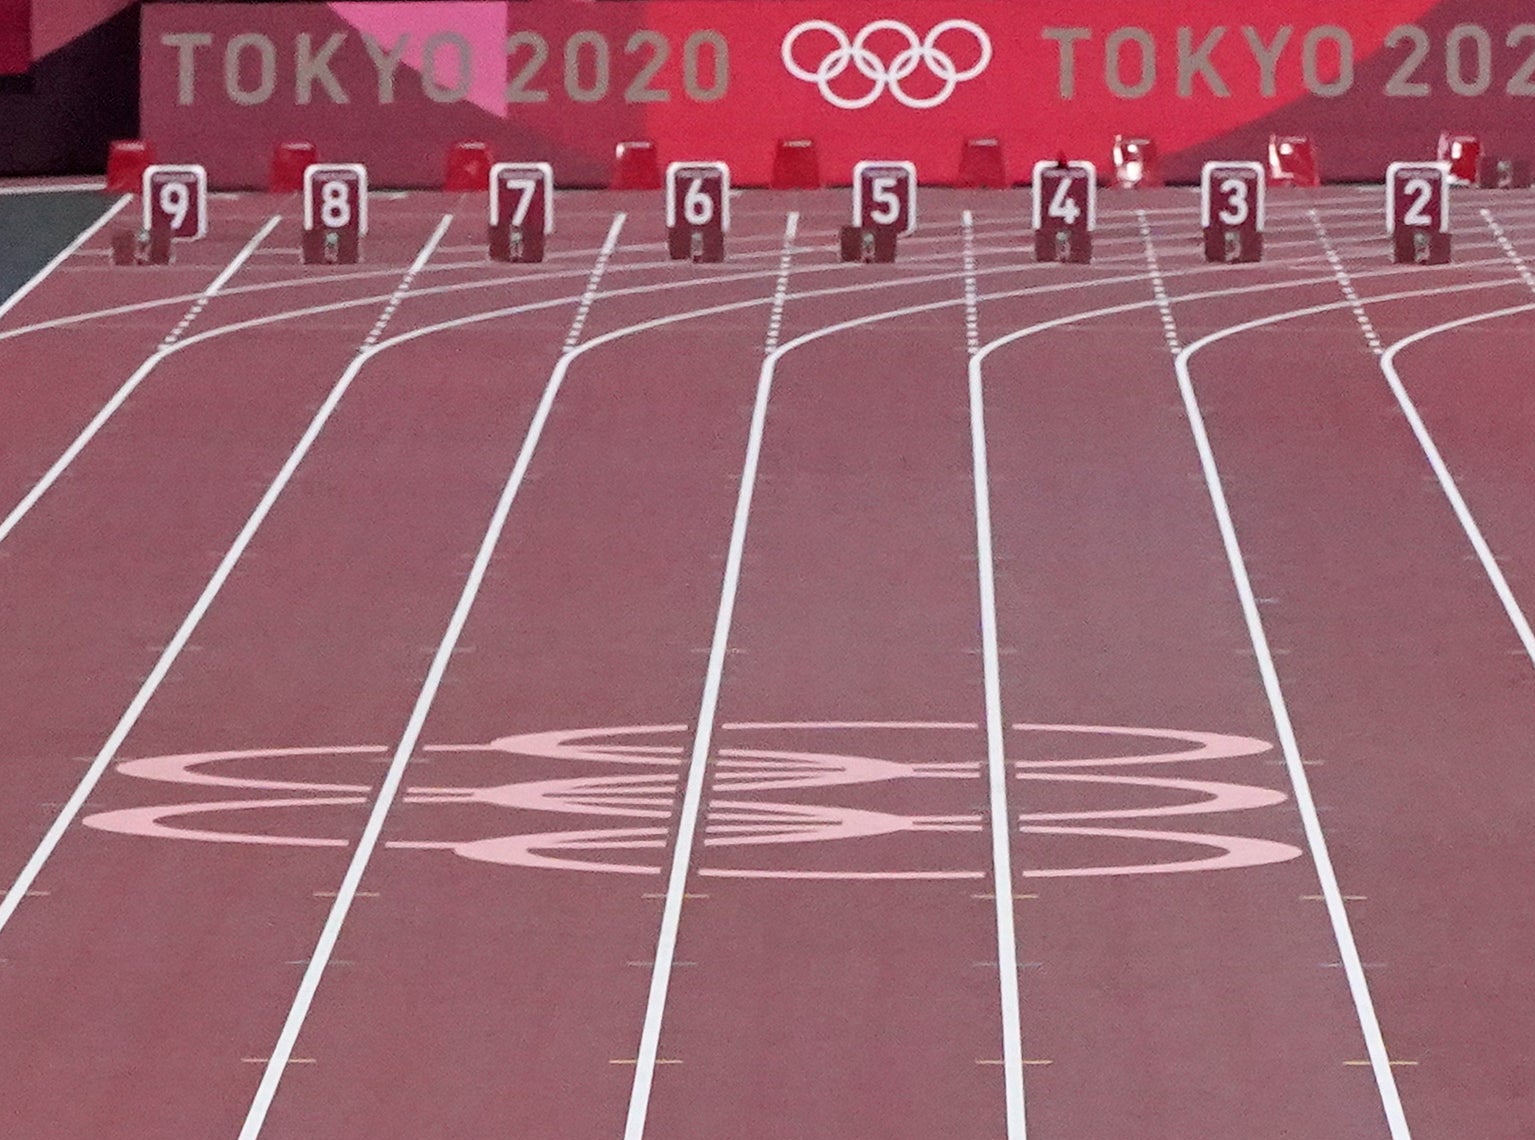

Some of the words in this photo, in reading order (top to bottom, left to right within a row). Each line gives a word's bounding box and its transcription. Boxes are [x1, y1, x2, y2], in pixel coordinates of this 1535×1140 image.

[161, 31, 472, 104] TOKYO
[505, 30, 729, 103] 2020
[1042, 25, 1355, 99] TOKYO
[160, 183, 189, 229] 9
[321, 181, 351, 228] 8
[505, 179, 537, 226] 7
[683, 179, 712, 226] 6
[870, 178, 899, 225] 5
[1049, 178, 1080, 224] 4
[1218, 178, 1248, 225] 3
[1403, 179, 1432, 225] 2
